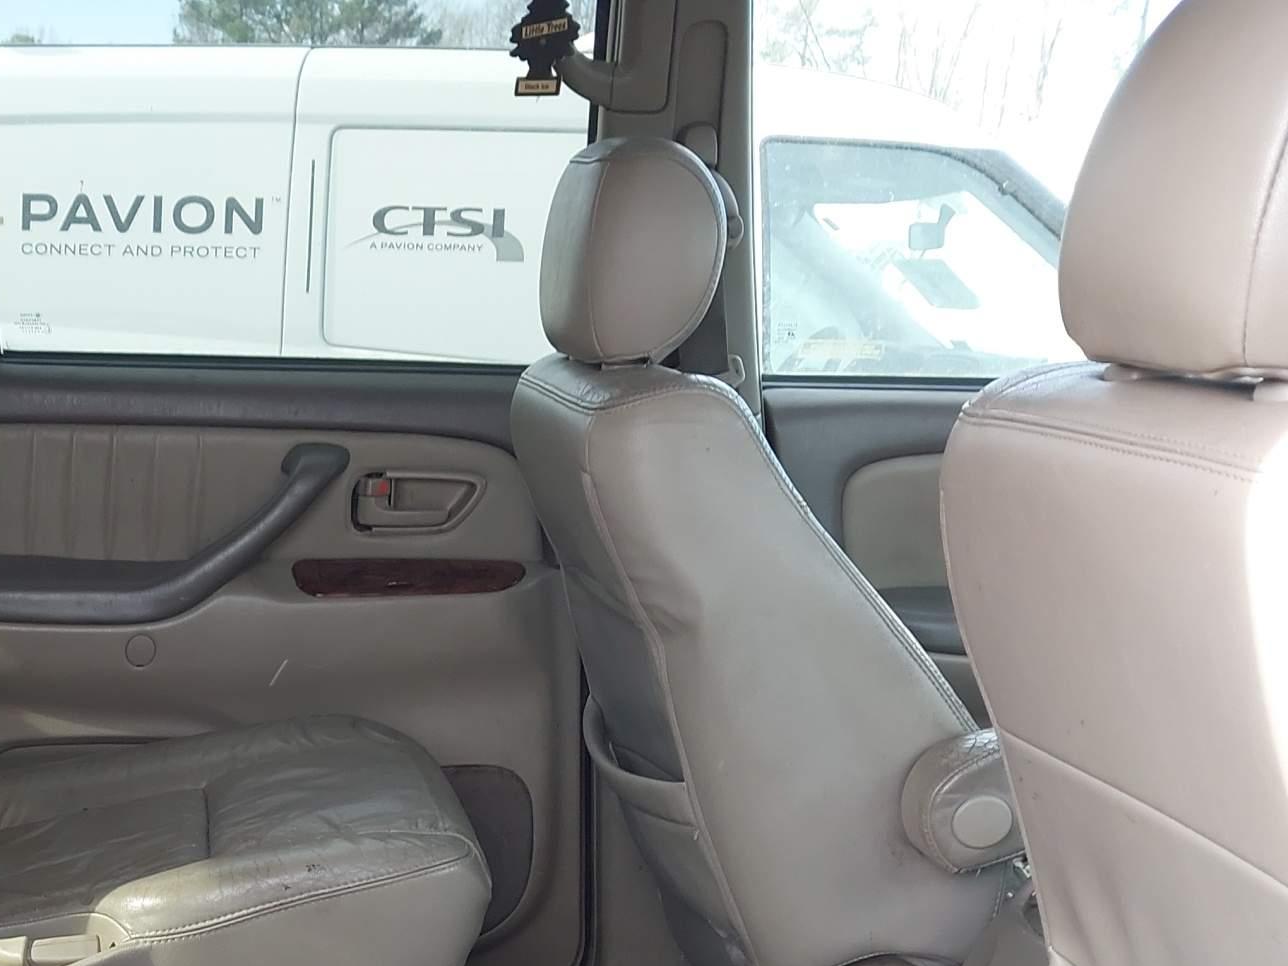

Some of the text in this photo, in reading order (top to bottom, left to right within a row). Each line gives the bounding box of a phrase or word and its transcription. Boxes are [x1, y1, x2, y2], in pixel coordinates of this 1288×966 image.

[22, 193, 264, 236] PAVION
[372, 204, 505, 238] CTSI
[21, 242, 261, 259] CONNECT AND PROTECT
[370, 242, 484, 252] A PAVION COMPANY
